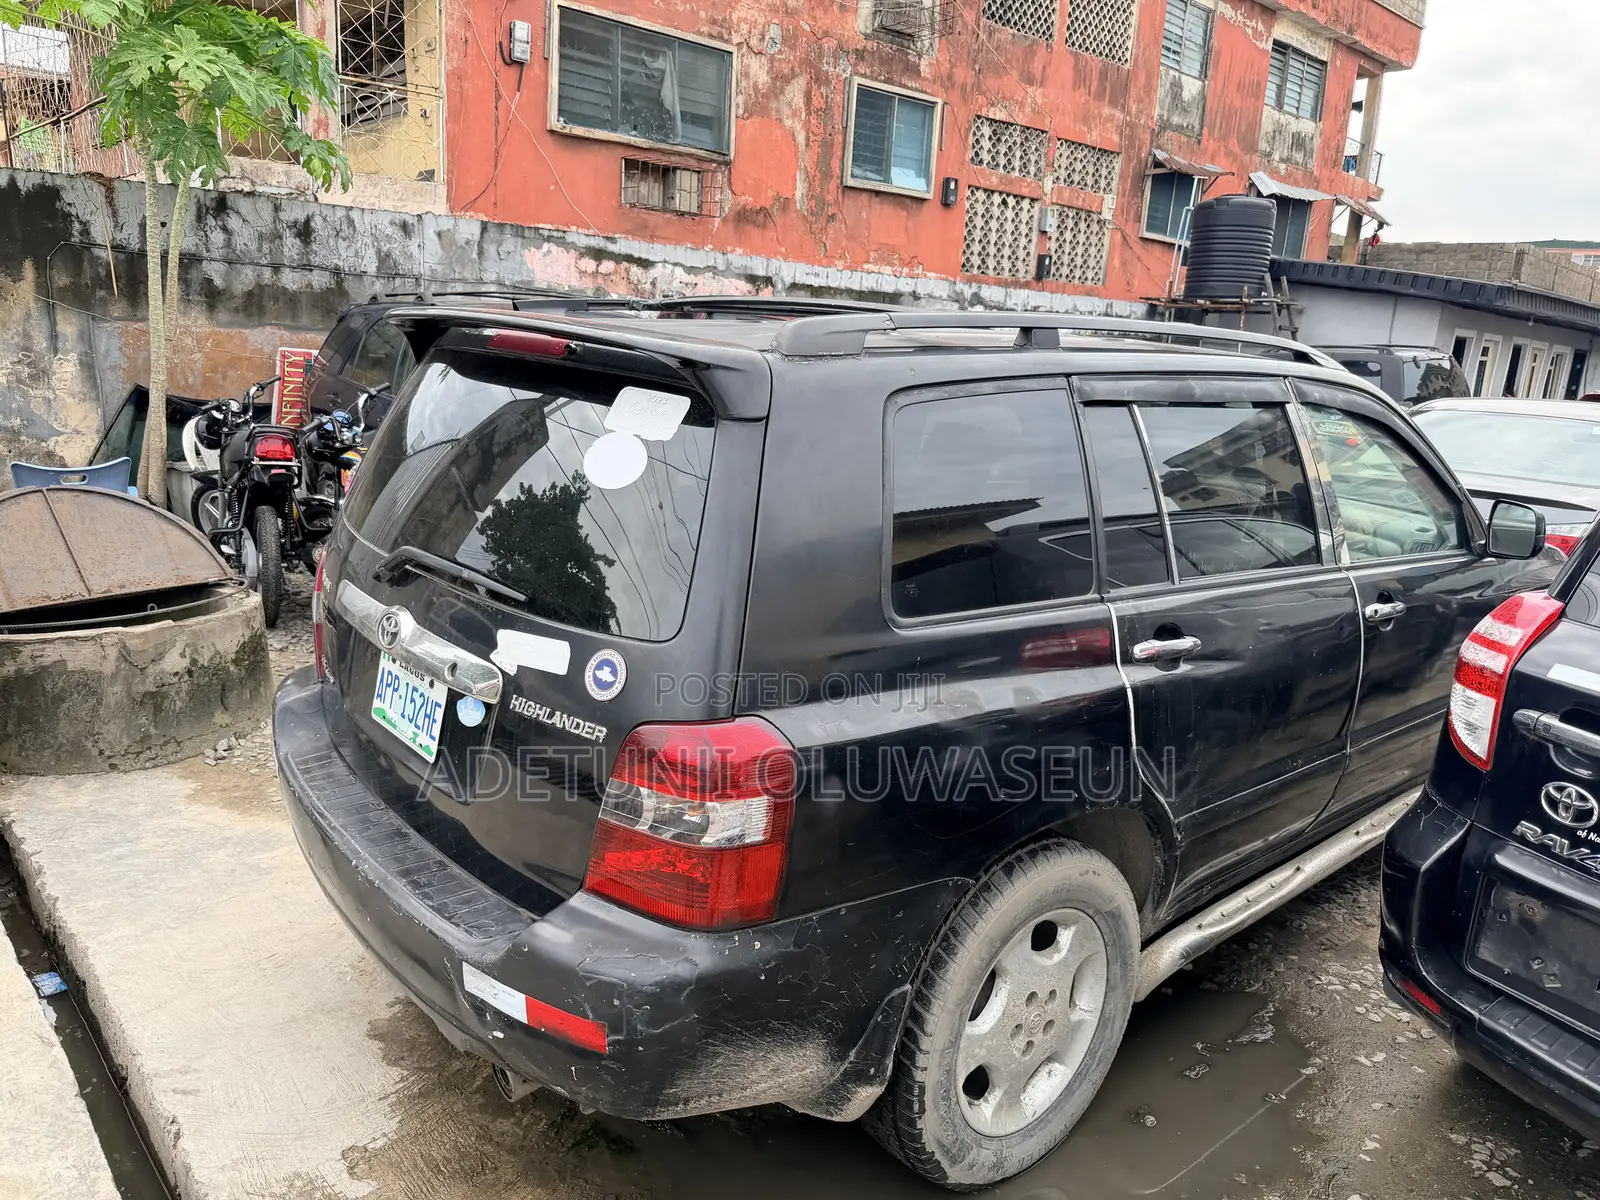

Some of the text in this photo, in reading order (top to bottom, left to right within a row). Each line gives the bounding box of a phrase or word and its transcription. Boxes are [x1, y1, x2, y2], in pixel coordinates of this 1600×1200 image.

[280, 351, 305, 427] NFINITY
[509, 693, 608, 744] HIGHLANDER
[1512, 820, 1600, 873] RAV4
